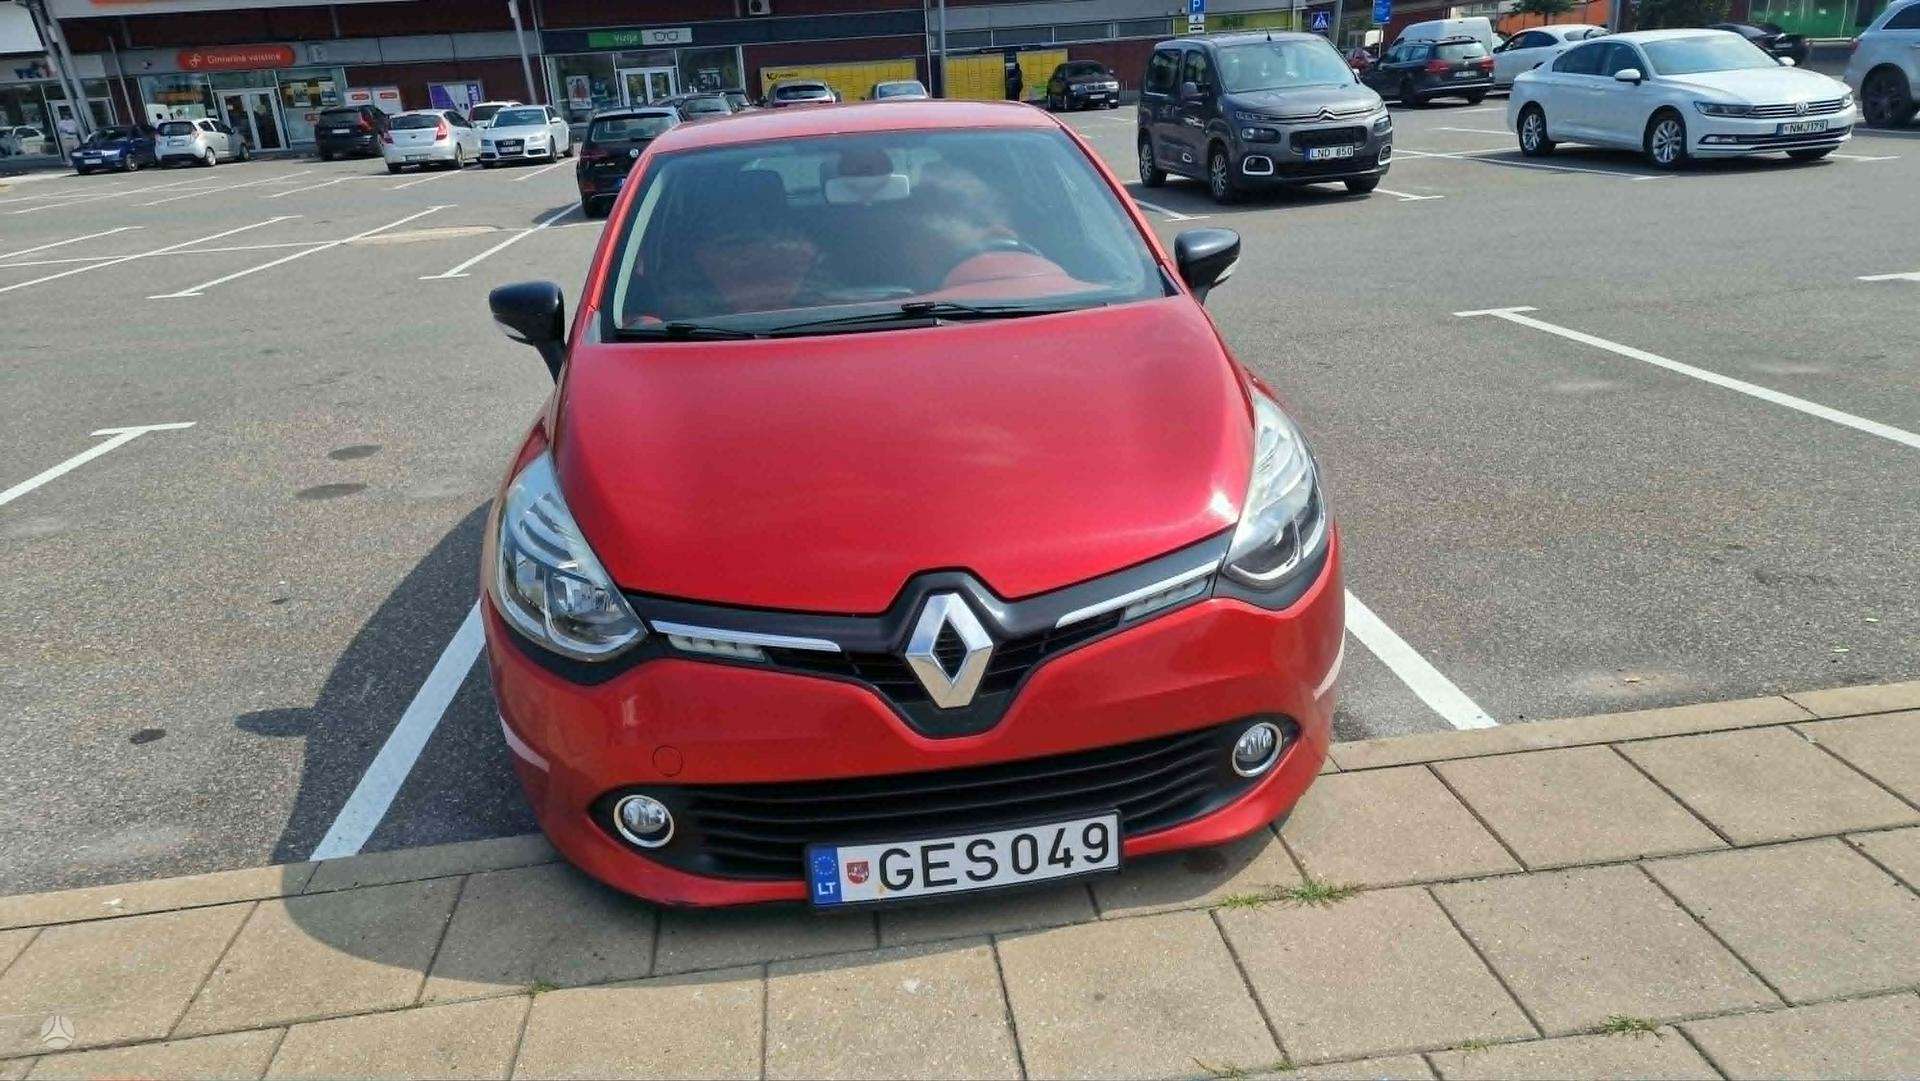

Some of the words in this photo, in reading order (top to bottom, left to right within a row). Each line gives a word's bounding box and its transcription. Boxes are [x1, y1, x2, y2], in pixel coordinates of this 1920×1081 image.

[1192, 0, 1201, 12] P
[1311, 148, 1330, 158] LND
[879, 822, 1110, 891] GES049
[817, 882, 835, 896] LT
